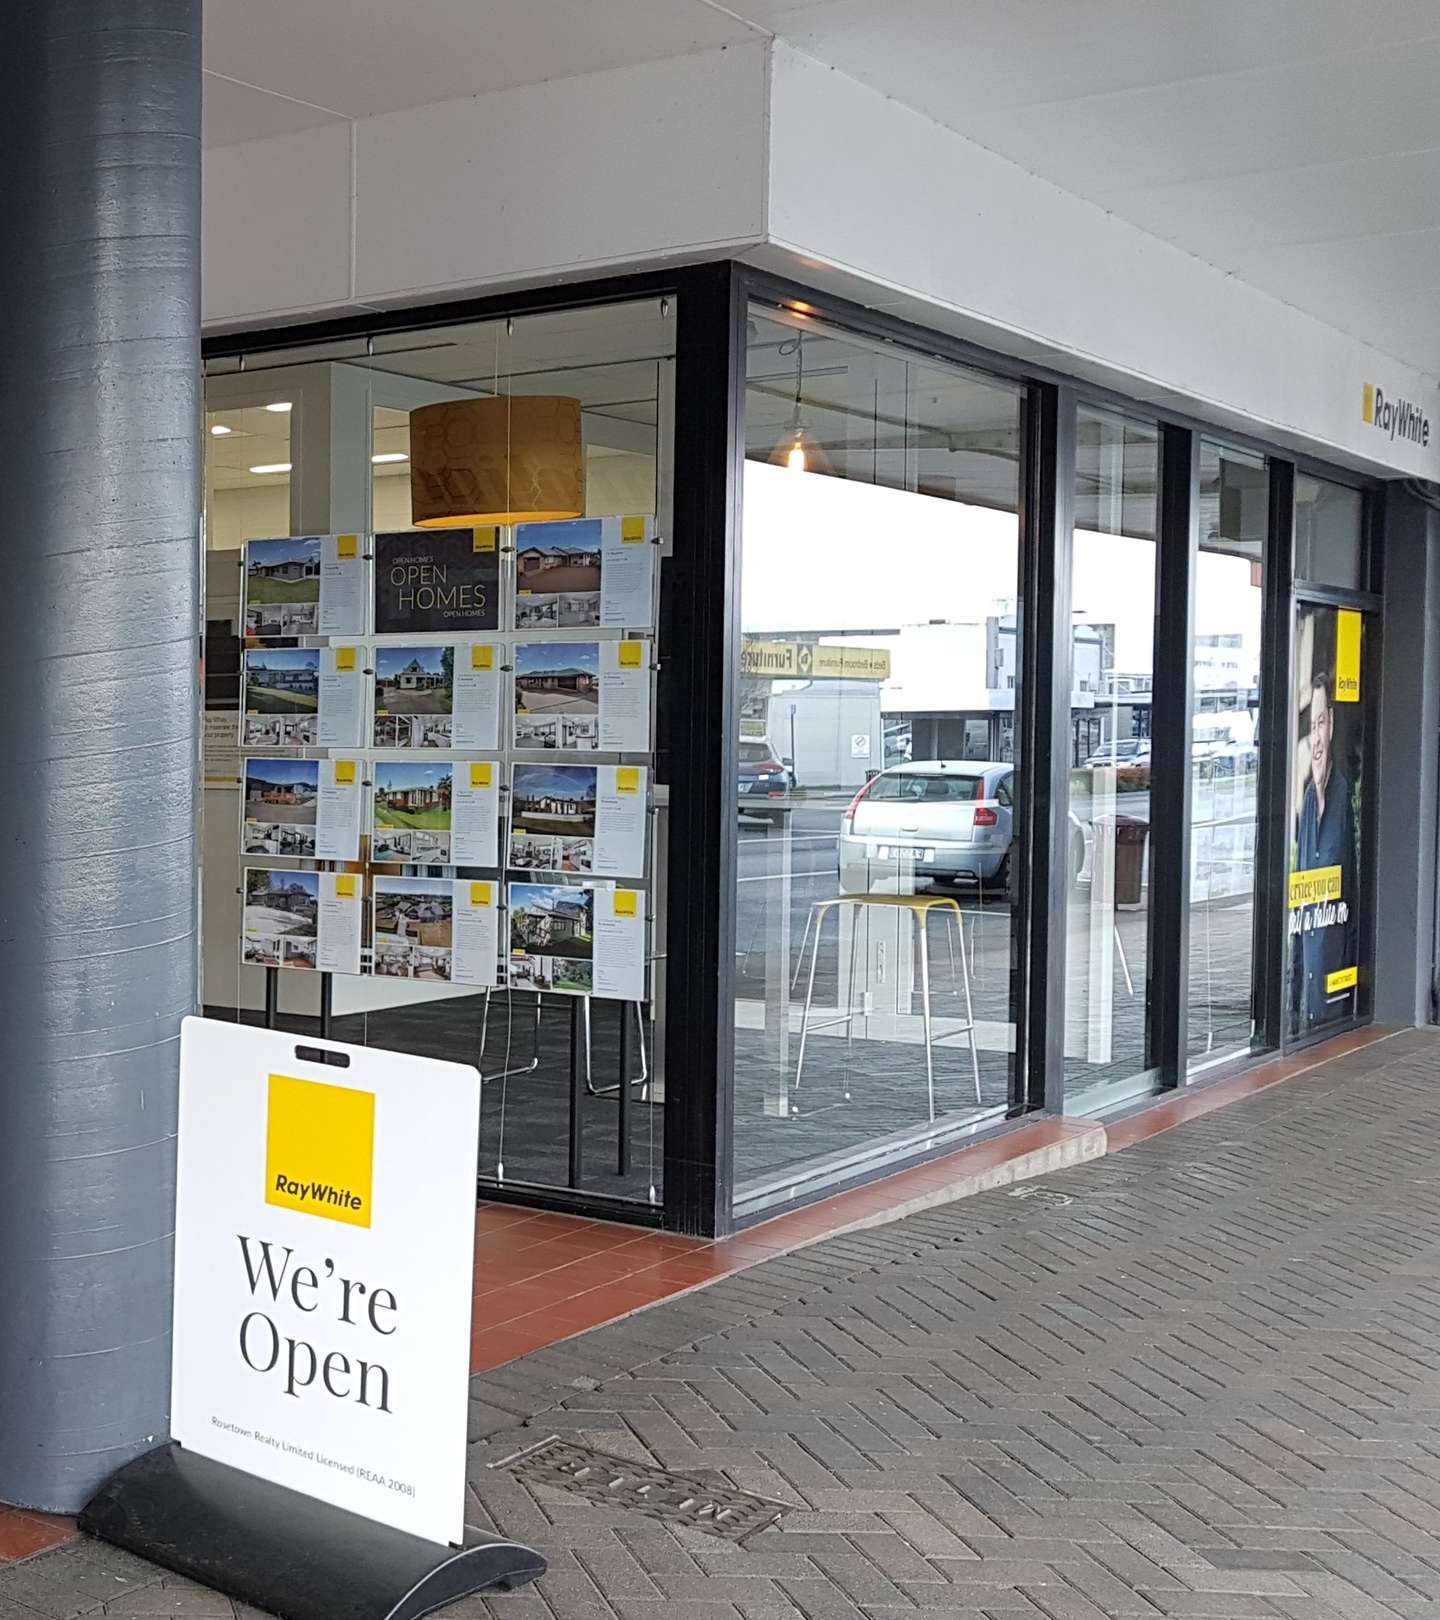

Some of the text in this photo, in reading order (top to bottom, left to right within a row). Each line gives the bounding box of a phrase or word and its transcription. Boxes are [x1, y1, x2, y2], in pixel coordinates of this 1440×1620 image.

[1374, 387, 1430, 447] RayWhite
[391, 564, 447, 586] OPEN
[399, 585, 486, 610] HOMES
[1312, 880, 1327, 901] you
[275, 1174, 362, 1211] RayWhite
[240, 1311, 393, 1414] Open
[211, 1416, 252, 1438] Rosetown
[254, 1431, 280, 1449] Realty
[282, 1442, 314, 1460] Limited
[316, 1453, 355, 1474] Licensed
[356, 1467, 386, 1486] (REAA
